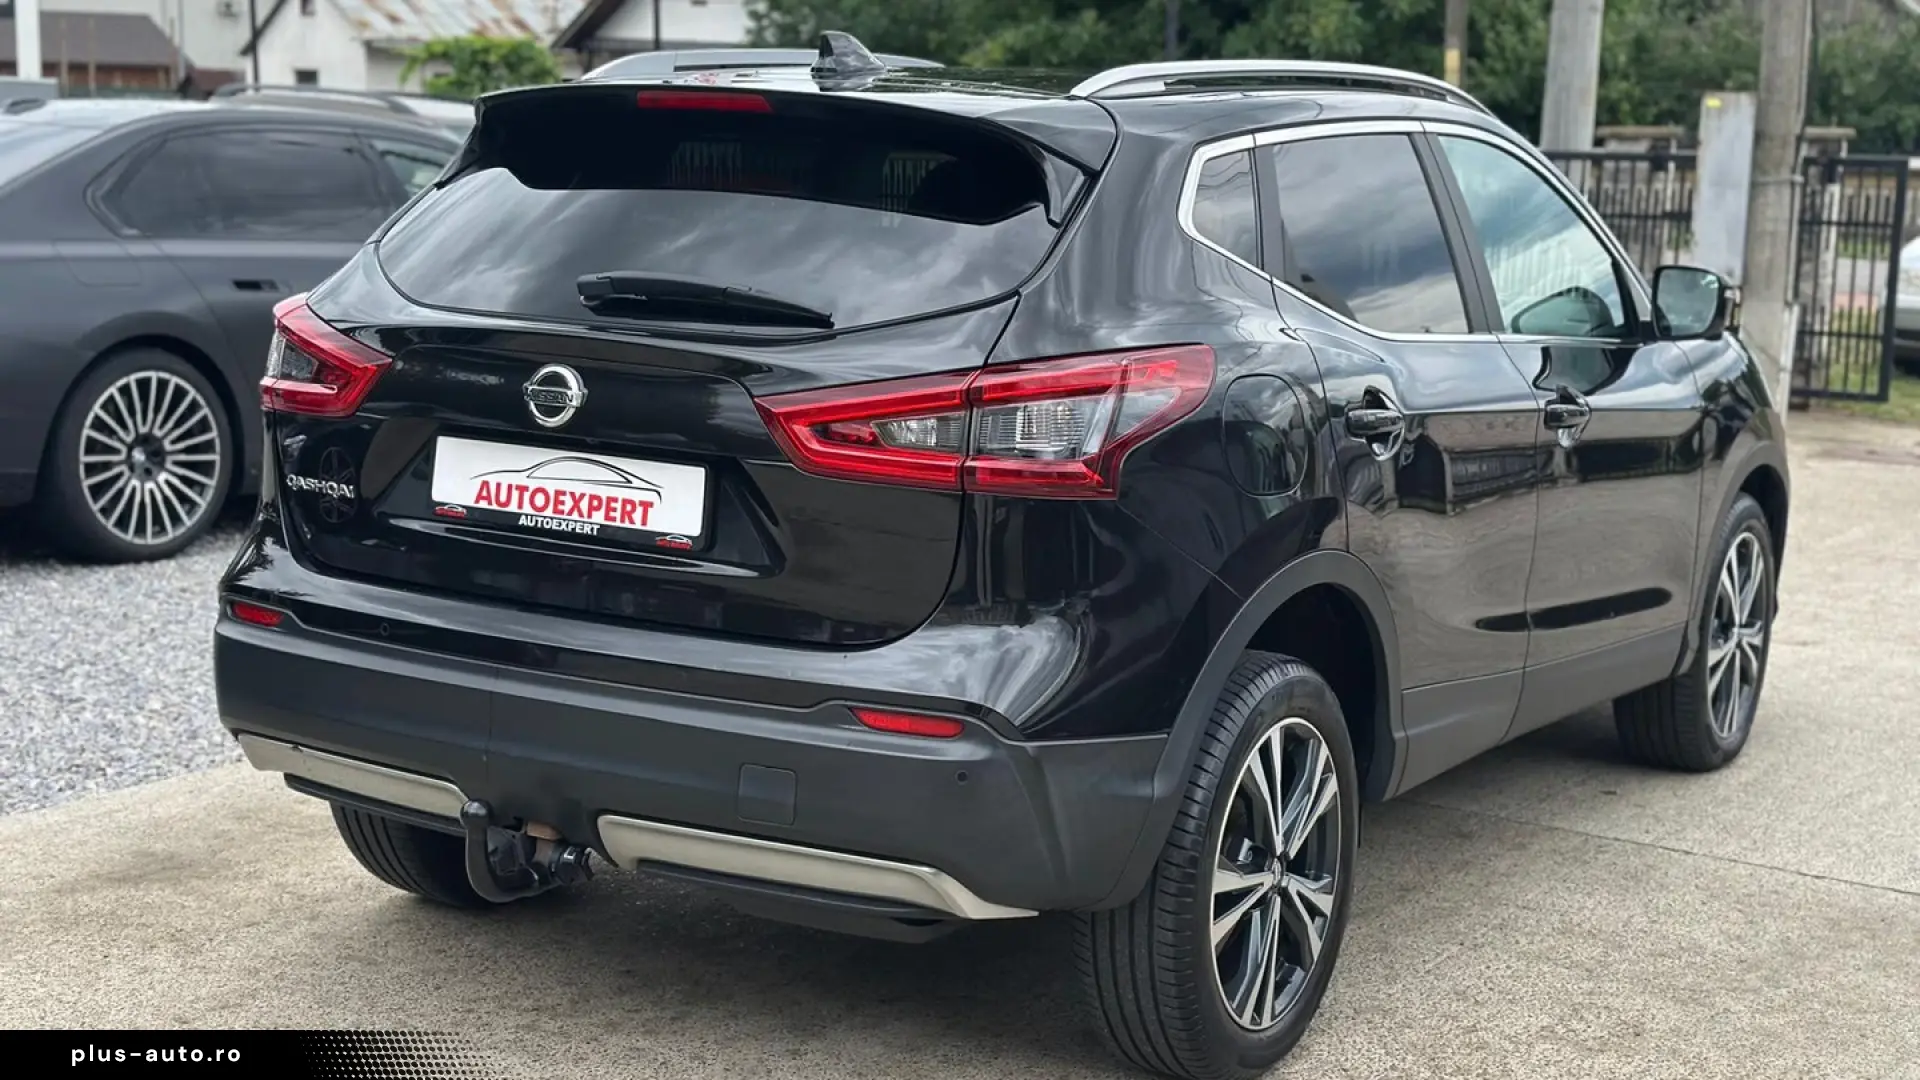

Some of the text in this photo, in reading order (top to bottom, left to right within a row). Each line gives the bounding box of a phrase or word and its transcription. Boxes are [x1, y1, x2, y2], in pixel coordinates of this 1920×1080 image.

[527, 389, 574, 404] NISSAN
[286, 474, 354, 499] QASHQAI
[474, 480, 654, 527] AUTOEXPERT
[518, 514, 600, 536] AUTOEXPERT
